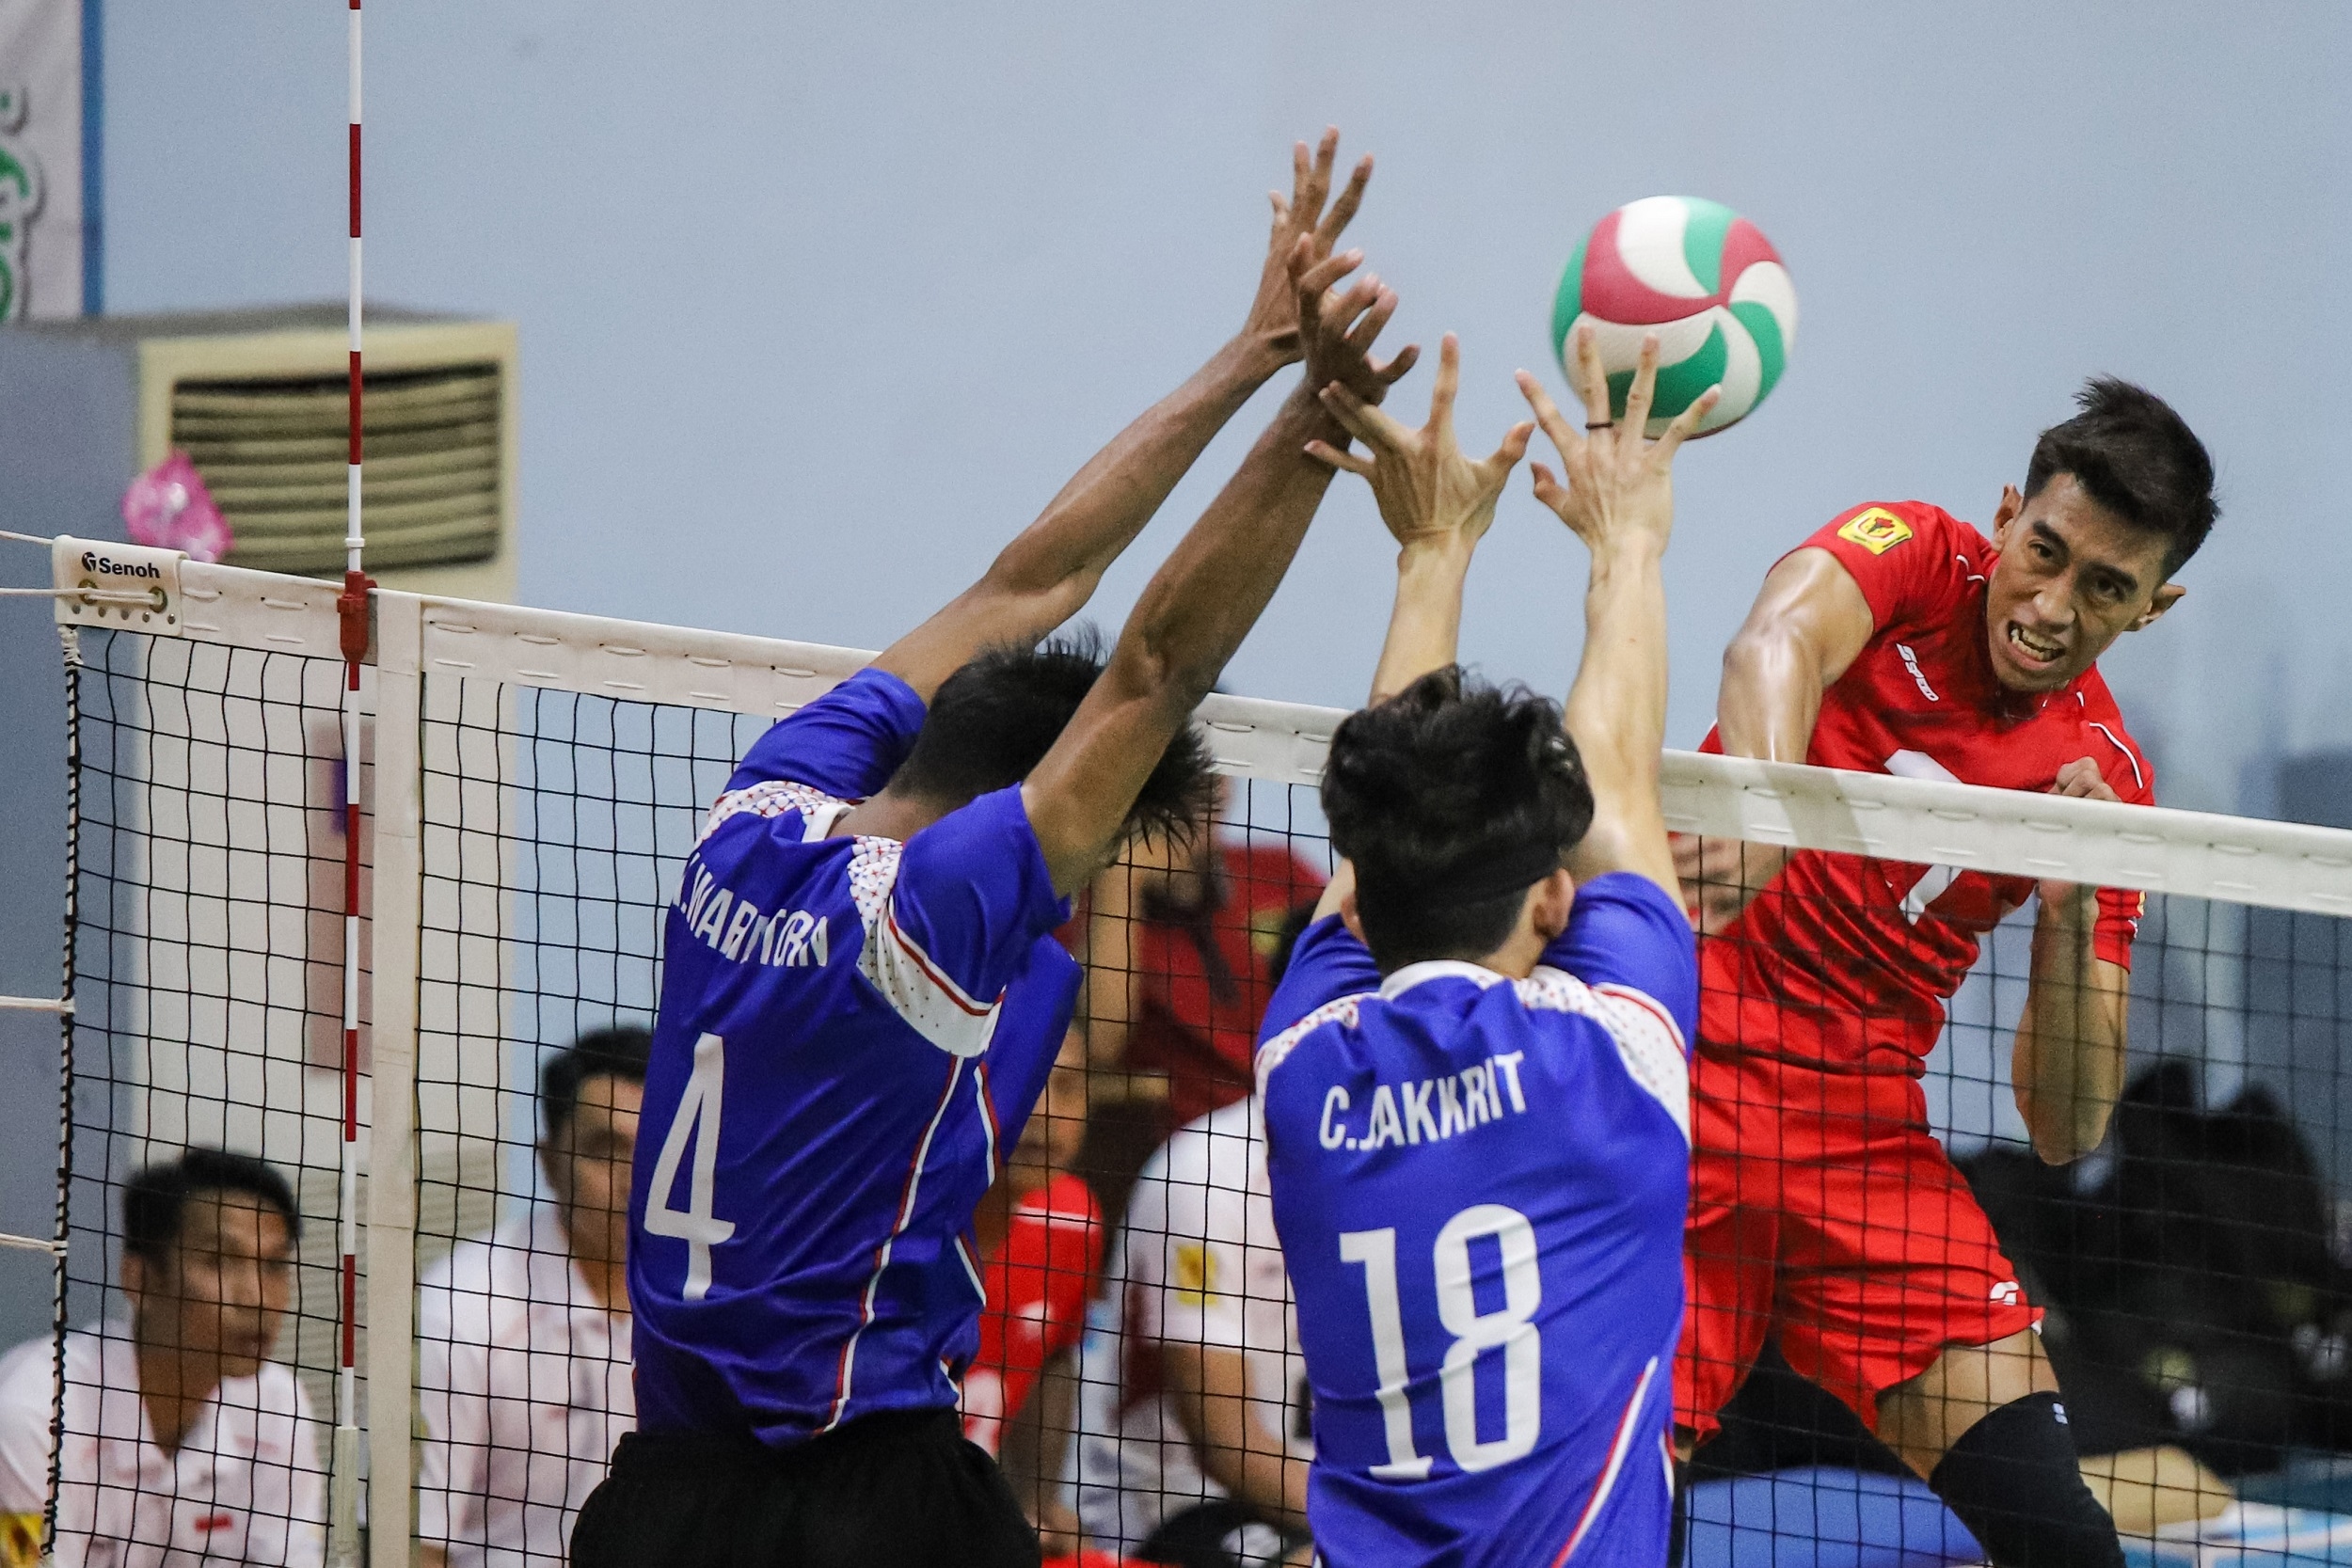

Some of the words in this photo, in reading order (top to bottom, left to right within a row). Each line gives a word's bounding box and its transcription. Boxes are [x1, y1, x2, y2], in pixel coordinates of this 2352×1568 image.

[99, 557, 160, 578] Senoh
[643, 1031, 736, 1302] 4
[1339, 1203, 1542, 1481] 18
